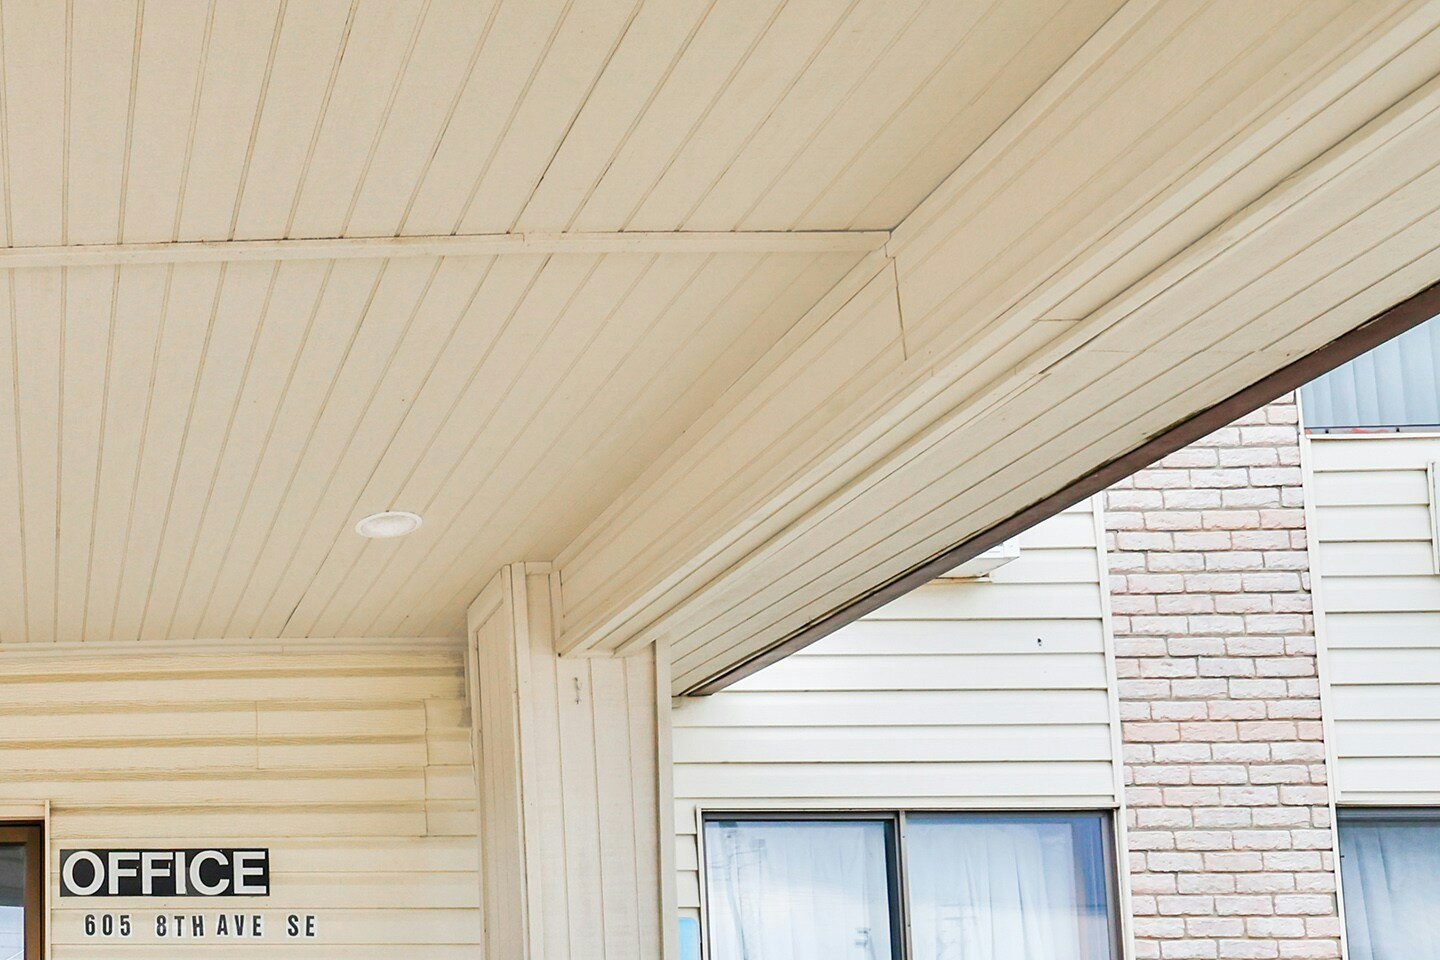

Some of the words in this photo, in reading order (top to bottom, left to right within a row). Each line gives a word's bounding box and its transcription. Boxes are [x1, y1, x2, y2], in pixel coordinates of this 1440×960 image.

[62, 850, 267, 895] OFFICE
[85, 914, 131, 936] 605
[156, 914, 204, 937] 8TH
[216, 914, 262, 937] AVE
[287, 914, 315, 937] SE
